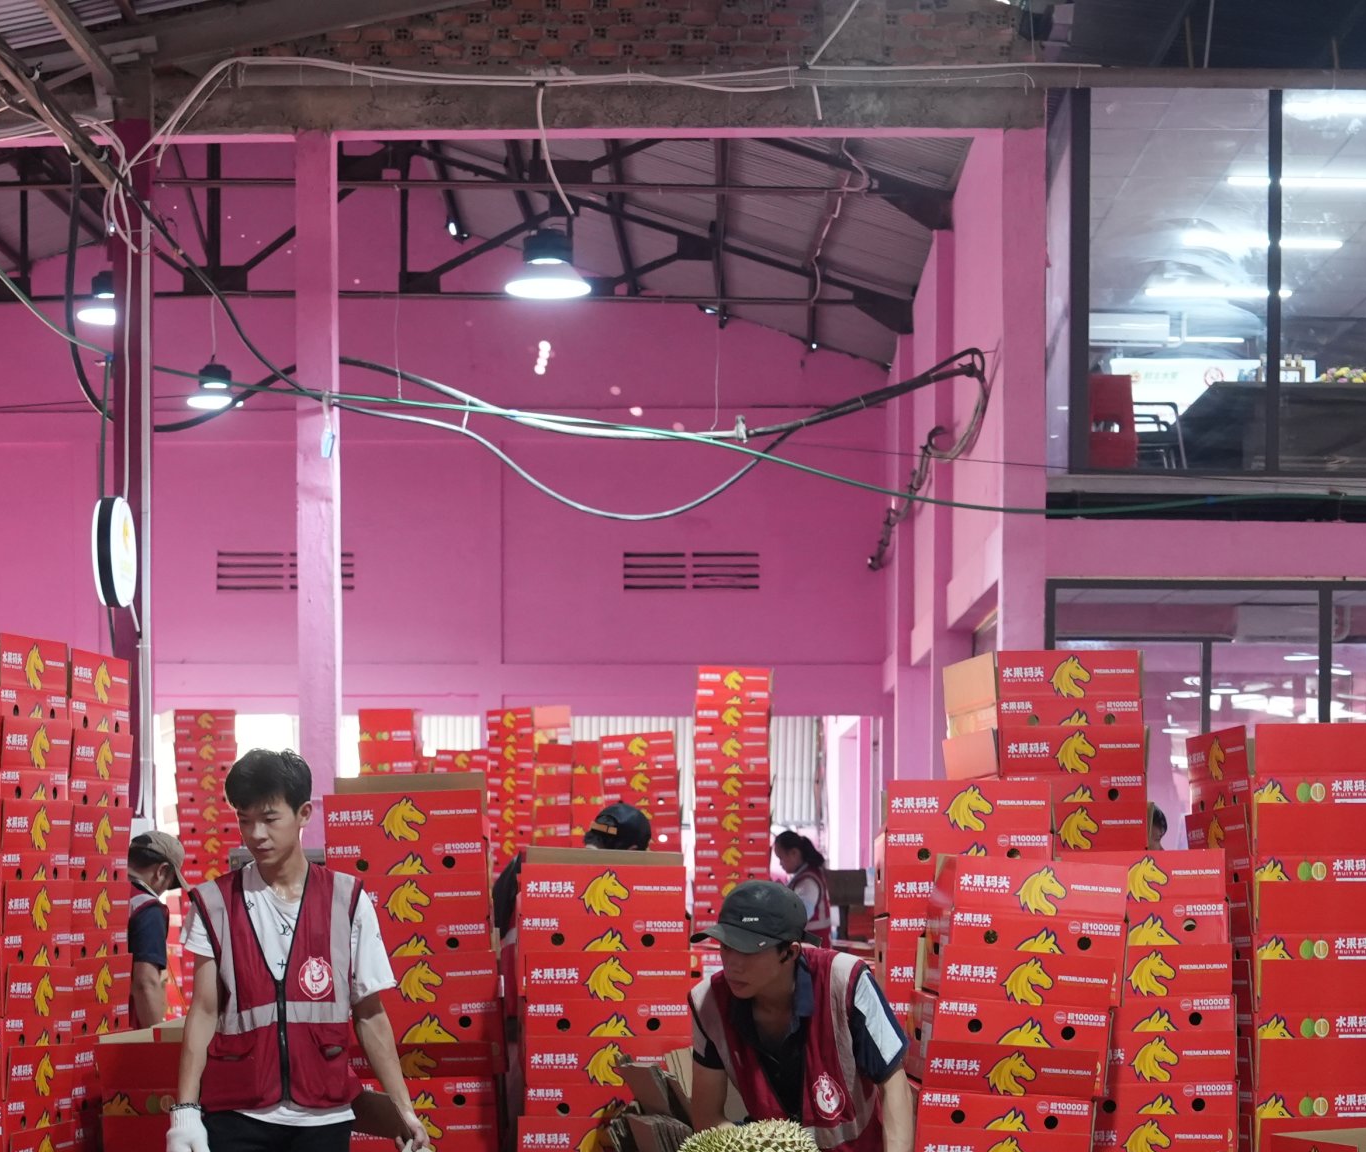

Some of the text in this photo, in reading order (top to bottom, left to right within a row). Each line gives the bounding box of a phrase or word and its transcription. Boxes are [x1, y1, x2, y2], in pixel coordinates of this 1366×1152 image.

[1003, 667, 1044, 678] 水果码头
[1008, 743, 1049, 753] 水果码头
[892, 797, 938, 808] 水果码头
[328, 810, 374, 822] 水果码头
[960, 874, 1009, 888] 水果码头
[527, 881, 574, 893] 水果码头
[954, 913, 991, 923] 水果码头
[531, 968, 578, 980] 水果码头
[947, 965, 996, 978] 水果码头
[939, 1001, 977, 1013] 水果码头
[531, 1054, 578, 1065] 水果码头
[930, 1058, 980, 1071] 水果码头
[922, 1093, 960, 1103] 水果码头
[523, 1133, 570, 1144] 水果码头
